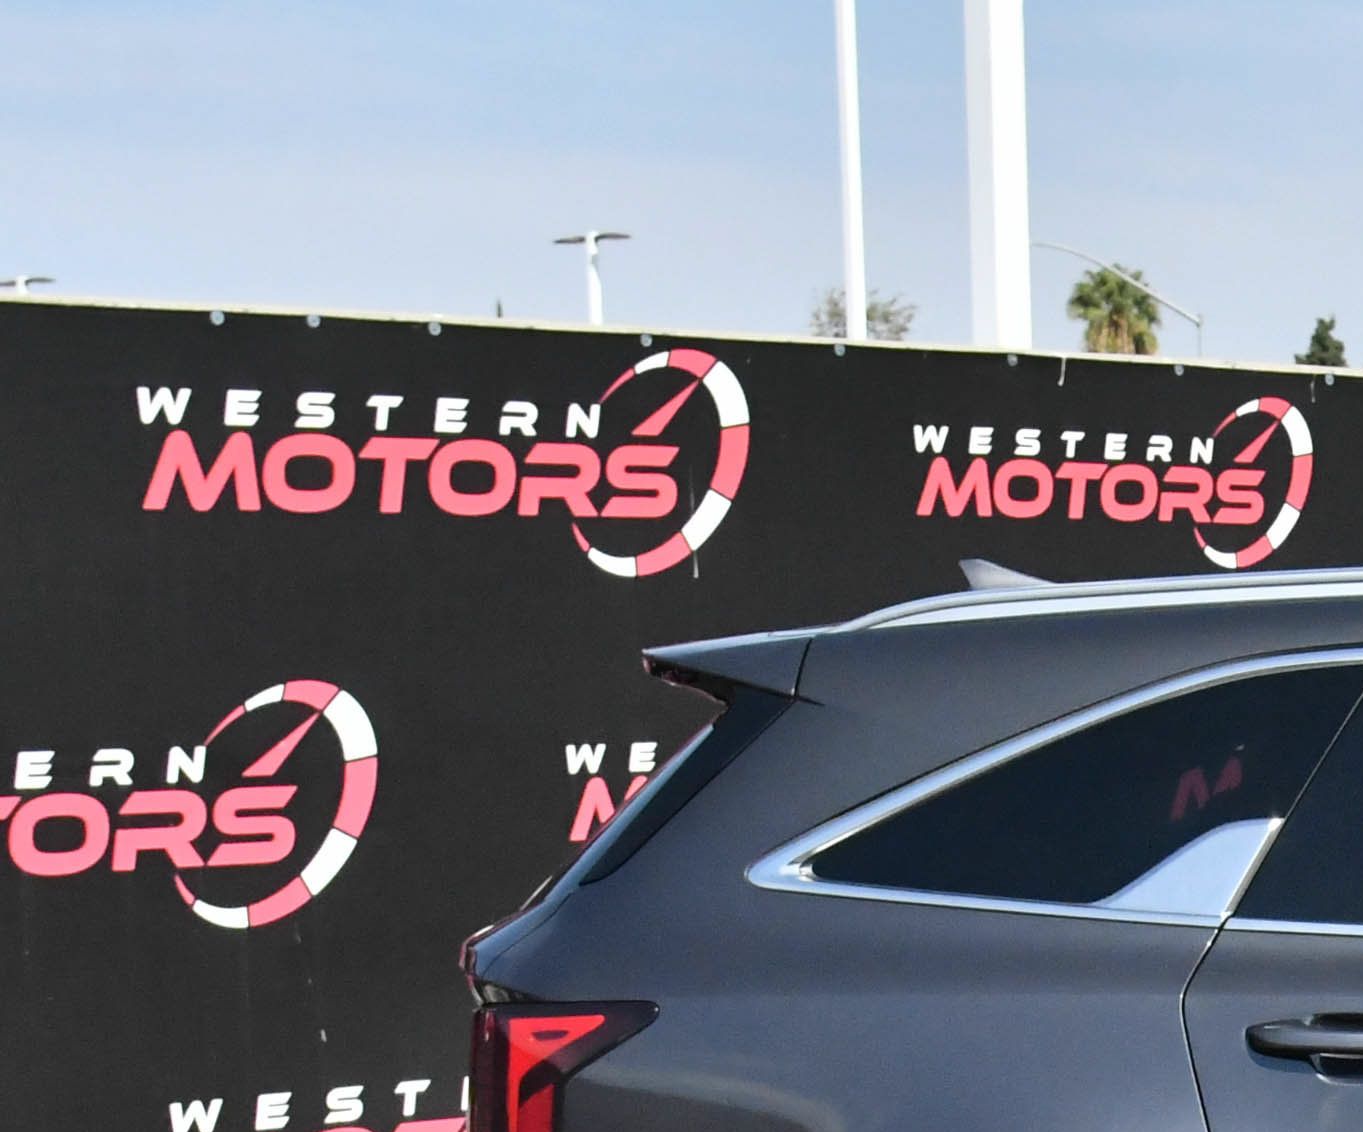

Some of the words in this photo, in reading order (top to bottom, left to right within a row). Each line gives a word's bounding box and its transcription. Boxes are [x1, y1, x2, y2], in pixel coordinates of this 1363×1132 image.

[136, 386, 601, 439] WESTERN
[913, 424, 1215, 465] WESTERN
[142, 429, 680, 519] MOTORS
[916, 456, 1266, 525] MOTORS
[0, 784, 298, 877] ORS
